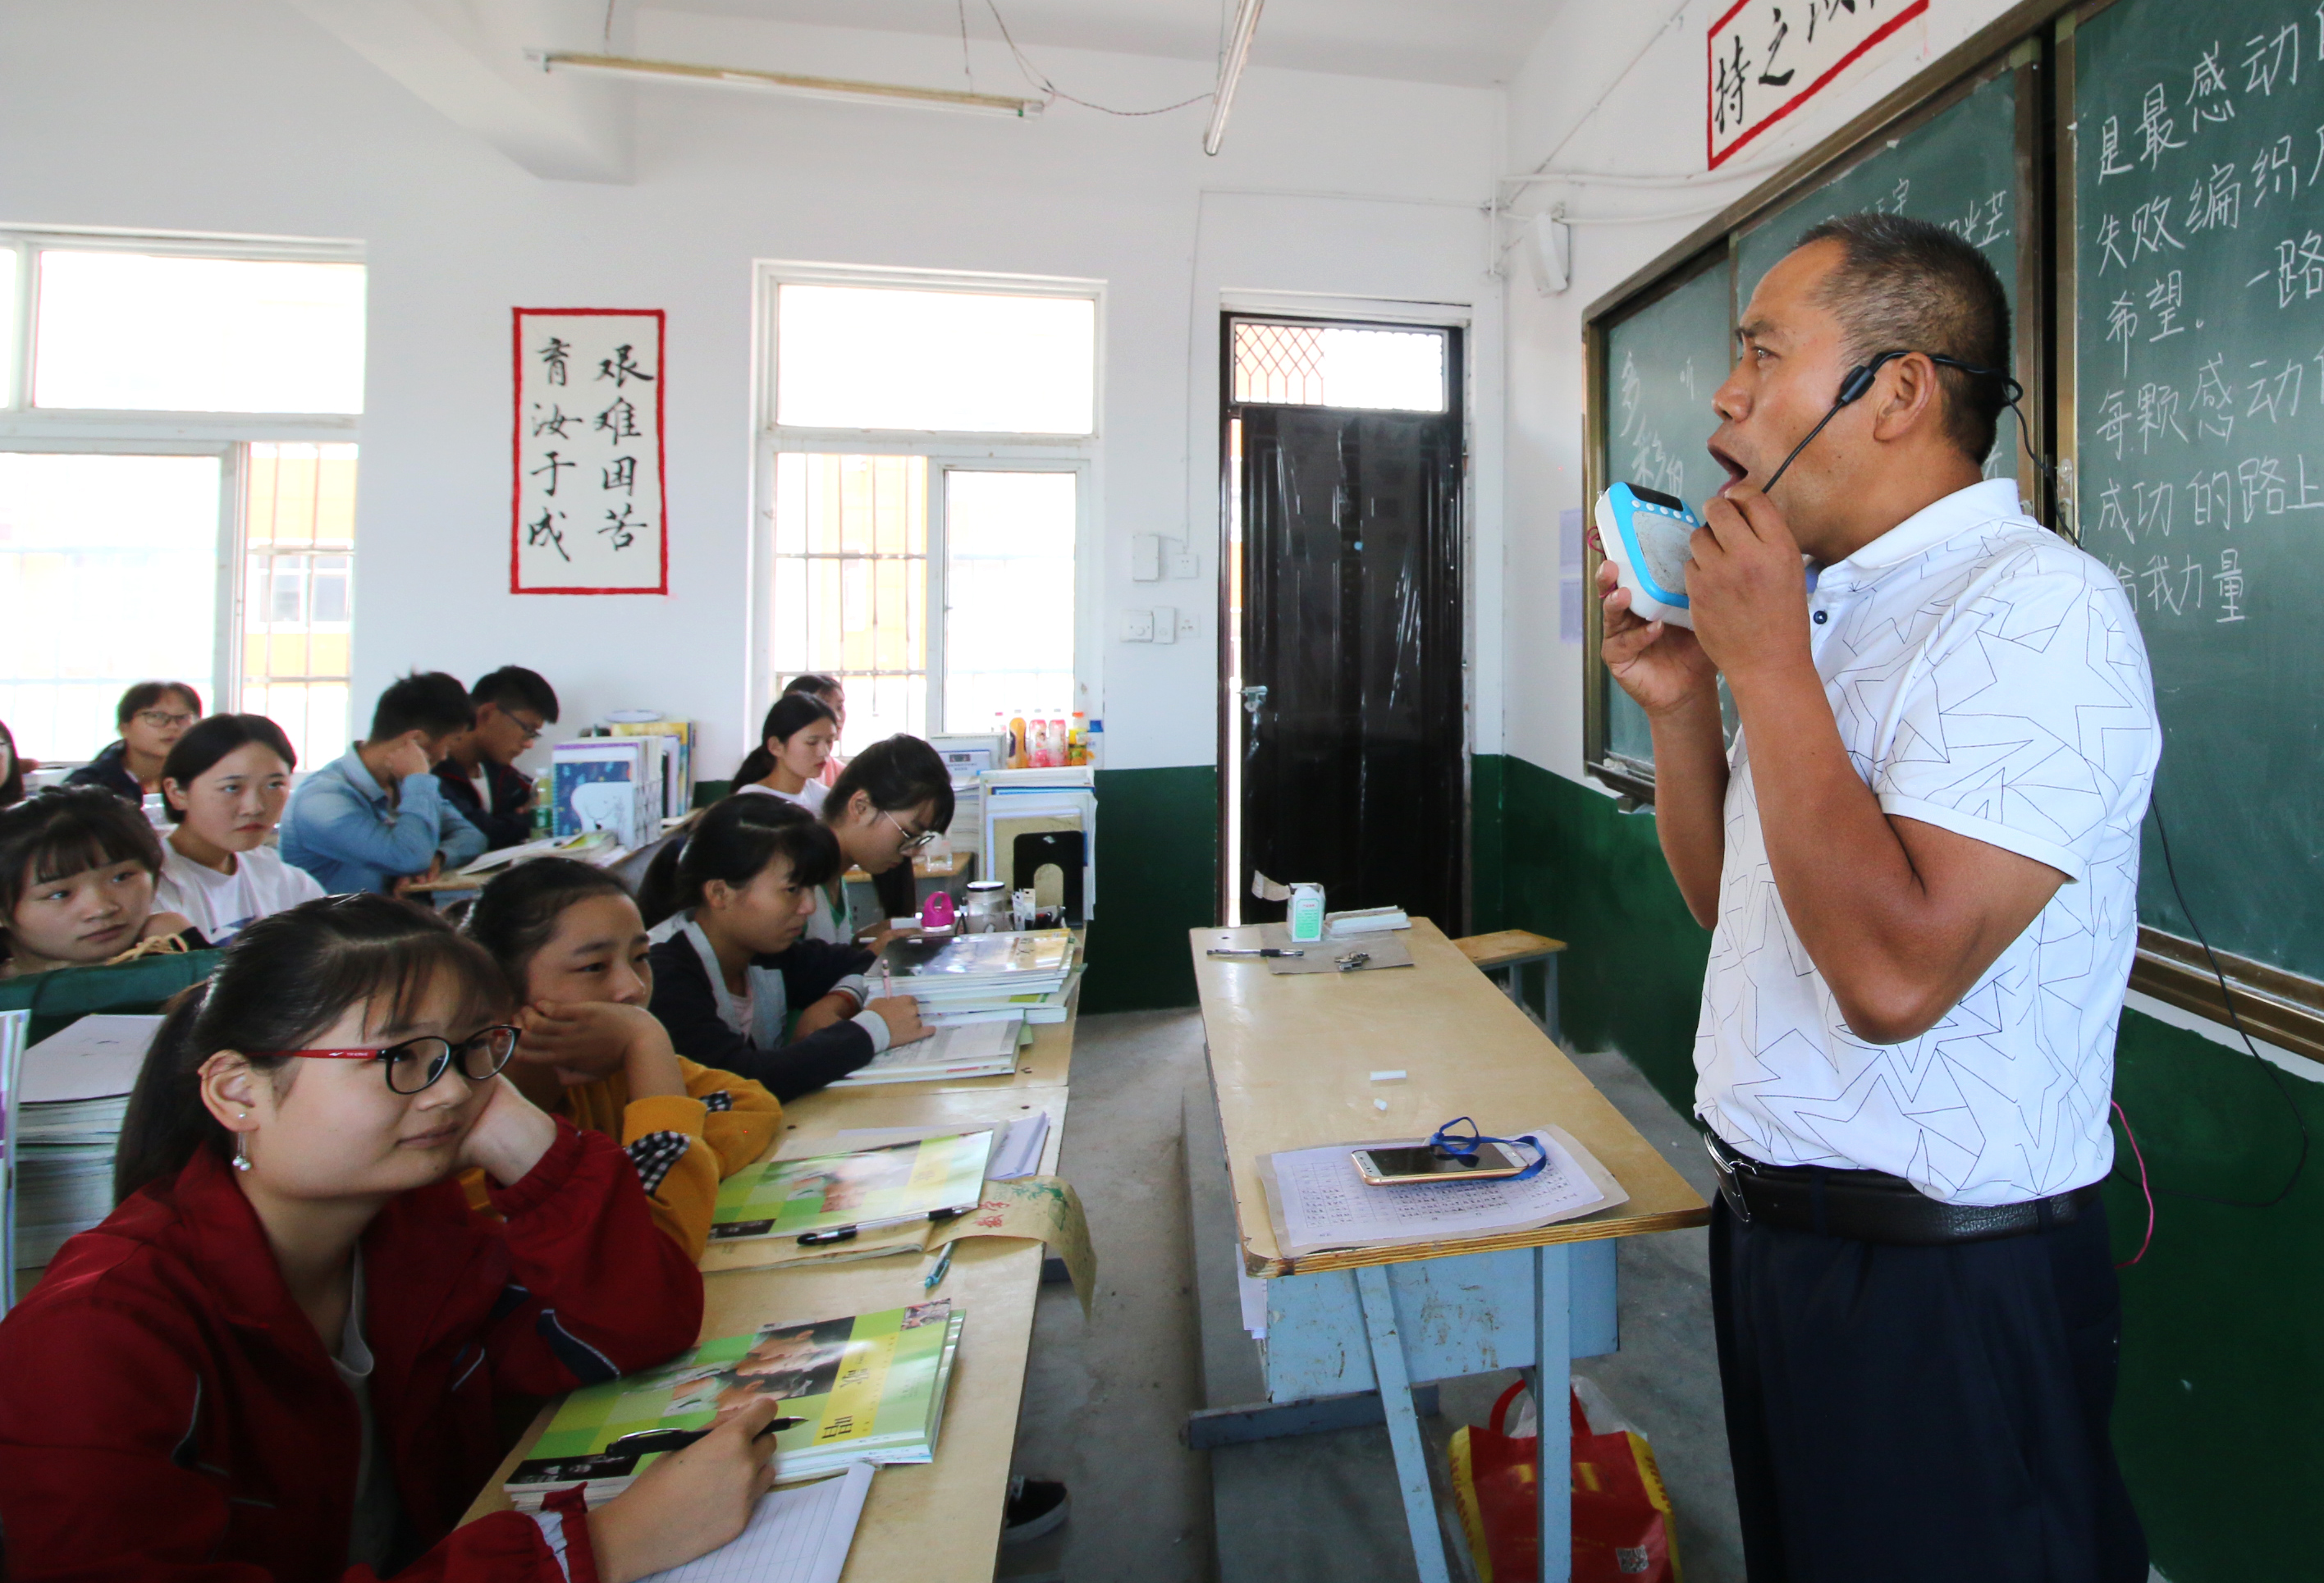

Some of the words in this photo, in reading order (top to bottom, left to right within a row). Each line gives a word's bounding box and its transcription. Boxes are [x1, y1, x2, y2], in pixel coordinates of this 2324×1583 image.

[1715, 0, 1875, 134] 持之以
[2098, 0, 2324, 185] 是最感动
[2098, 123, 2324, 277] 失败编织
[594, 344, 655, 551] 艰难困苦
[2096, 350, 2324, 461] 每颗感动
[2098, 454, 2324, 545] 成功的路上
